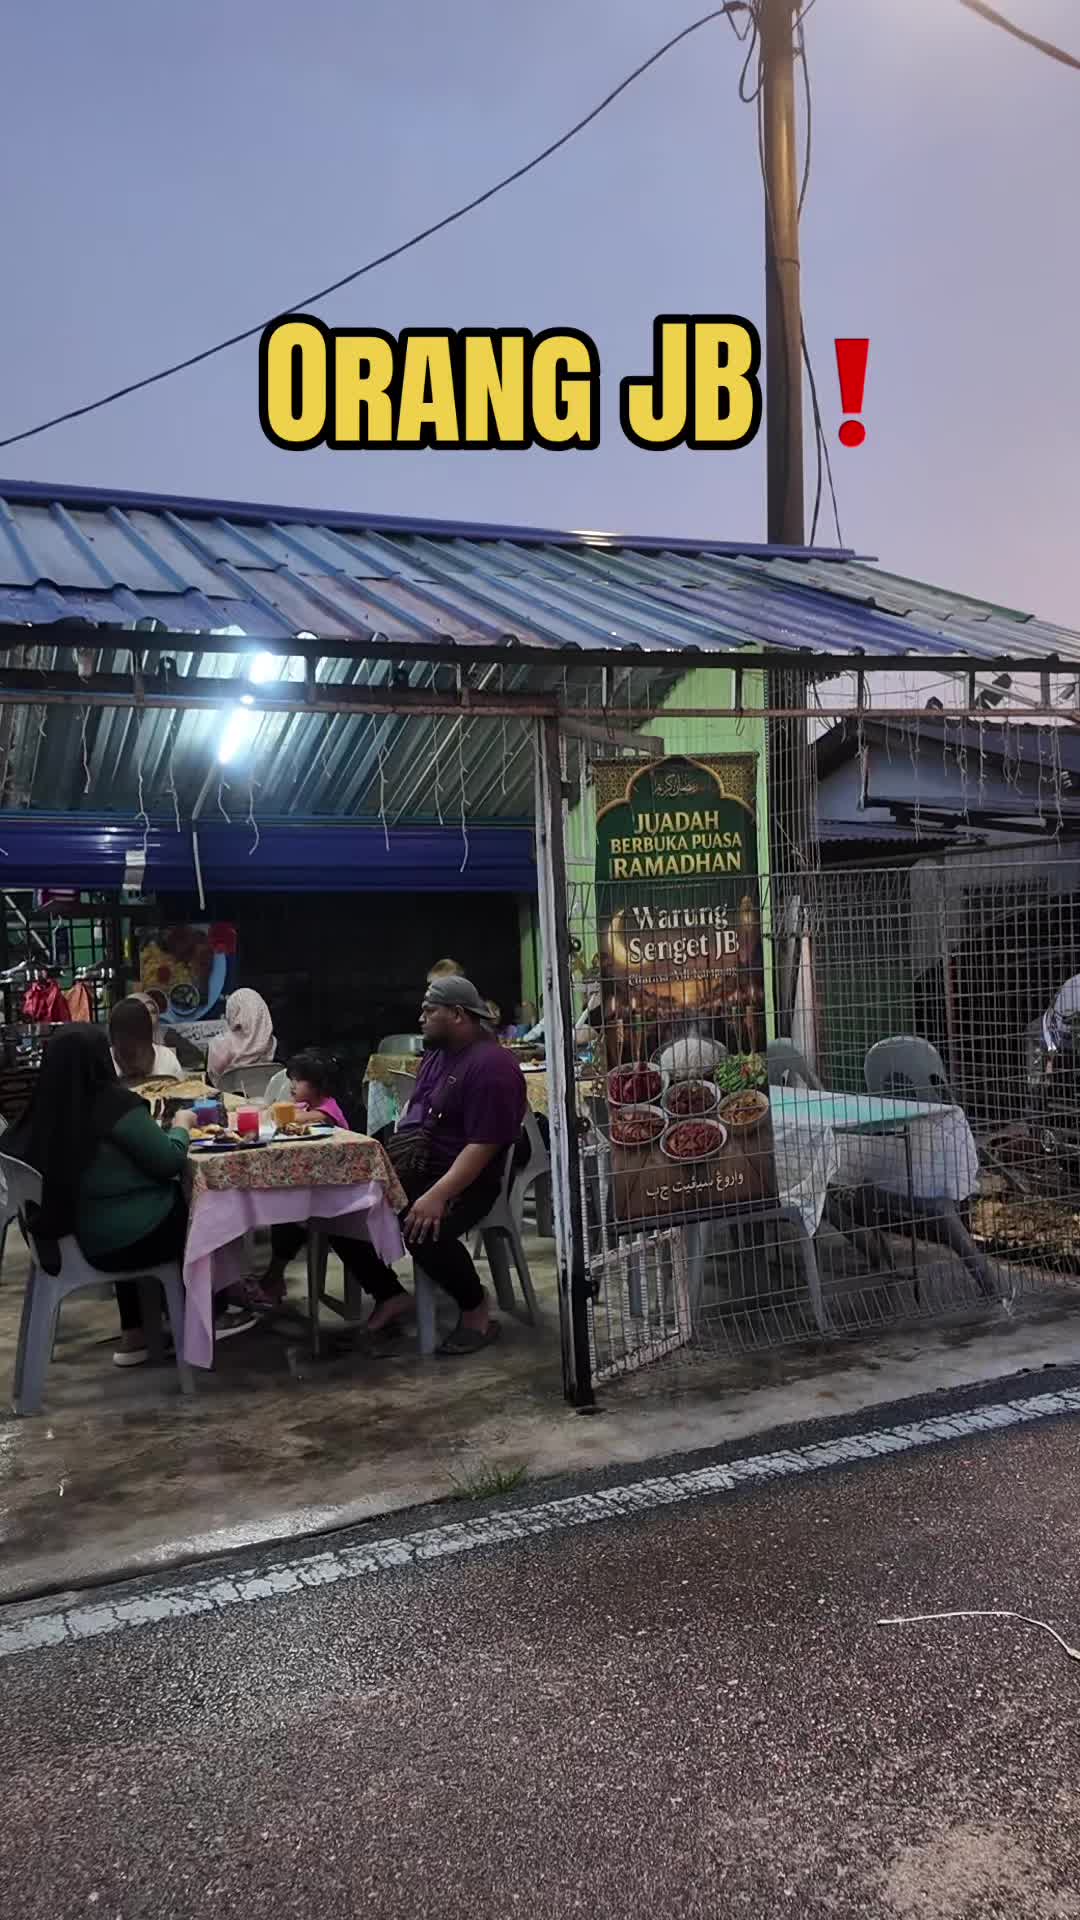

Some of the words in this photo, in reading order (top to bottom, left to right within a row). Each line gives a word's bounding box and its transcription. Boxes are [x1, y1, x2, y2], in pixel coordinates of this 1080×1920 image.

[634, 810, 719, 834] JUADAH
[610, 834, 688, 854] BERBUKA
[692, 832, 742, 849] PUASA
[612, 851, 741, 880] RAMADHAN
[632, 904, 728, 930] Warung
[629, 934, 708, 965] Senget
[714, 931, 739, 960] JB
